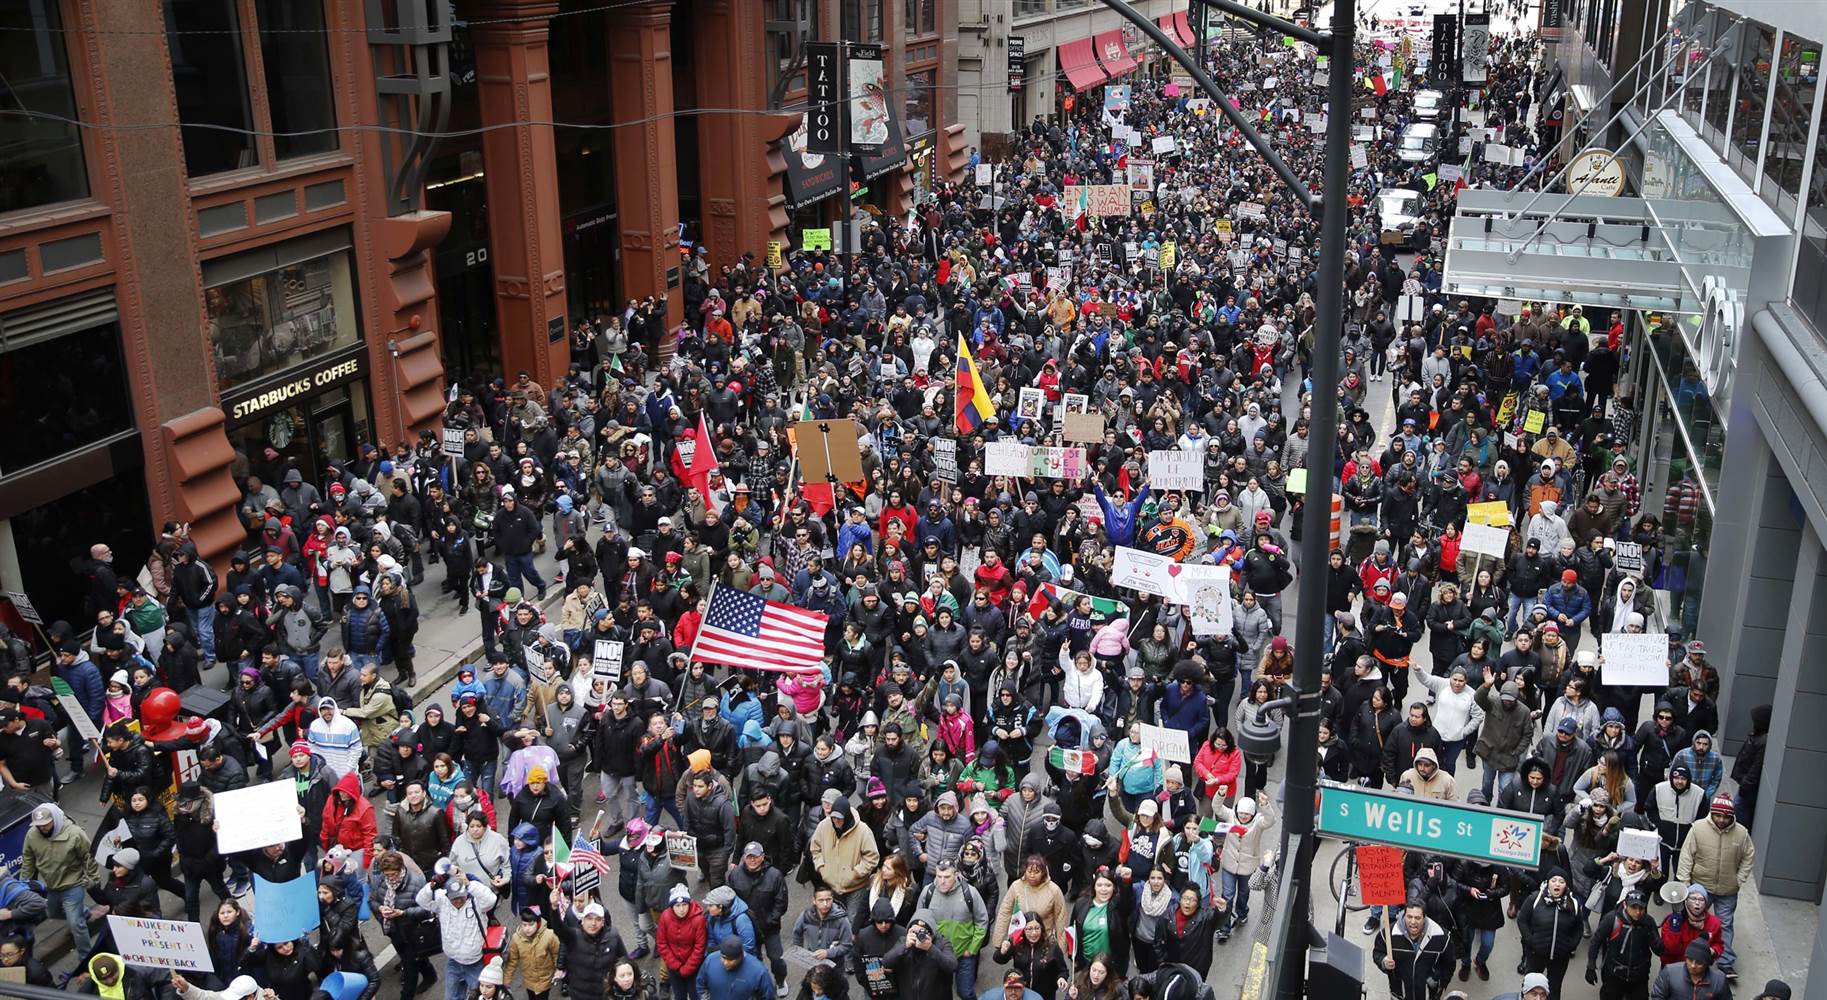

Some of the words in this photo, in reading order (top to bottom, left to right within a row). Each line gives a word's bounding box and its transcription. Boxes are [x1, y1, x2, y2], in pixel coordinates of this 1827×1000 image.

[1438, 23, 1448, 80] TATTOO
[817, 55, 829, 141] TATTOO
[1572, 172, 1620, 185] Aanti
[1098, 187, 1127, 197] BAN
[1099, 198, 1129, 207] WALL
[466, 248, 487, 266] 20
[233, 378, 311, 419] STARBUCKS
[315, 359, 358, 386] COFFEE
[445, 430, 463, 442] NO!
[936, 440, 955, 452] NO!
[938, 459, 956, 471] NO!
[1034, 467, 1043, 476] EL
[1618, 543, 1640, 558] NO!
[586, 596, 604, 616] NO!
[597, 641, 622, 661] NO!
[1340, 803, 1349, 817] S
[1364, 801, 1441, 838] Wells
[1456, 821, 1473, 837] St
[1368, 856, 1391, 864] THE
